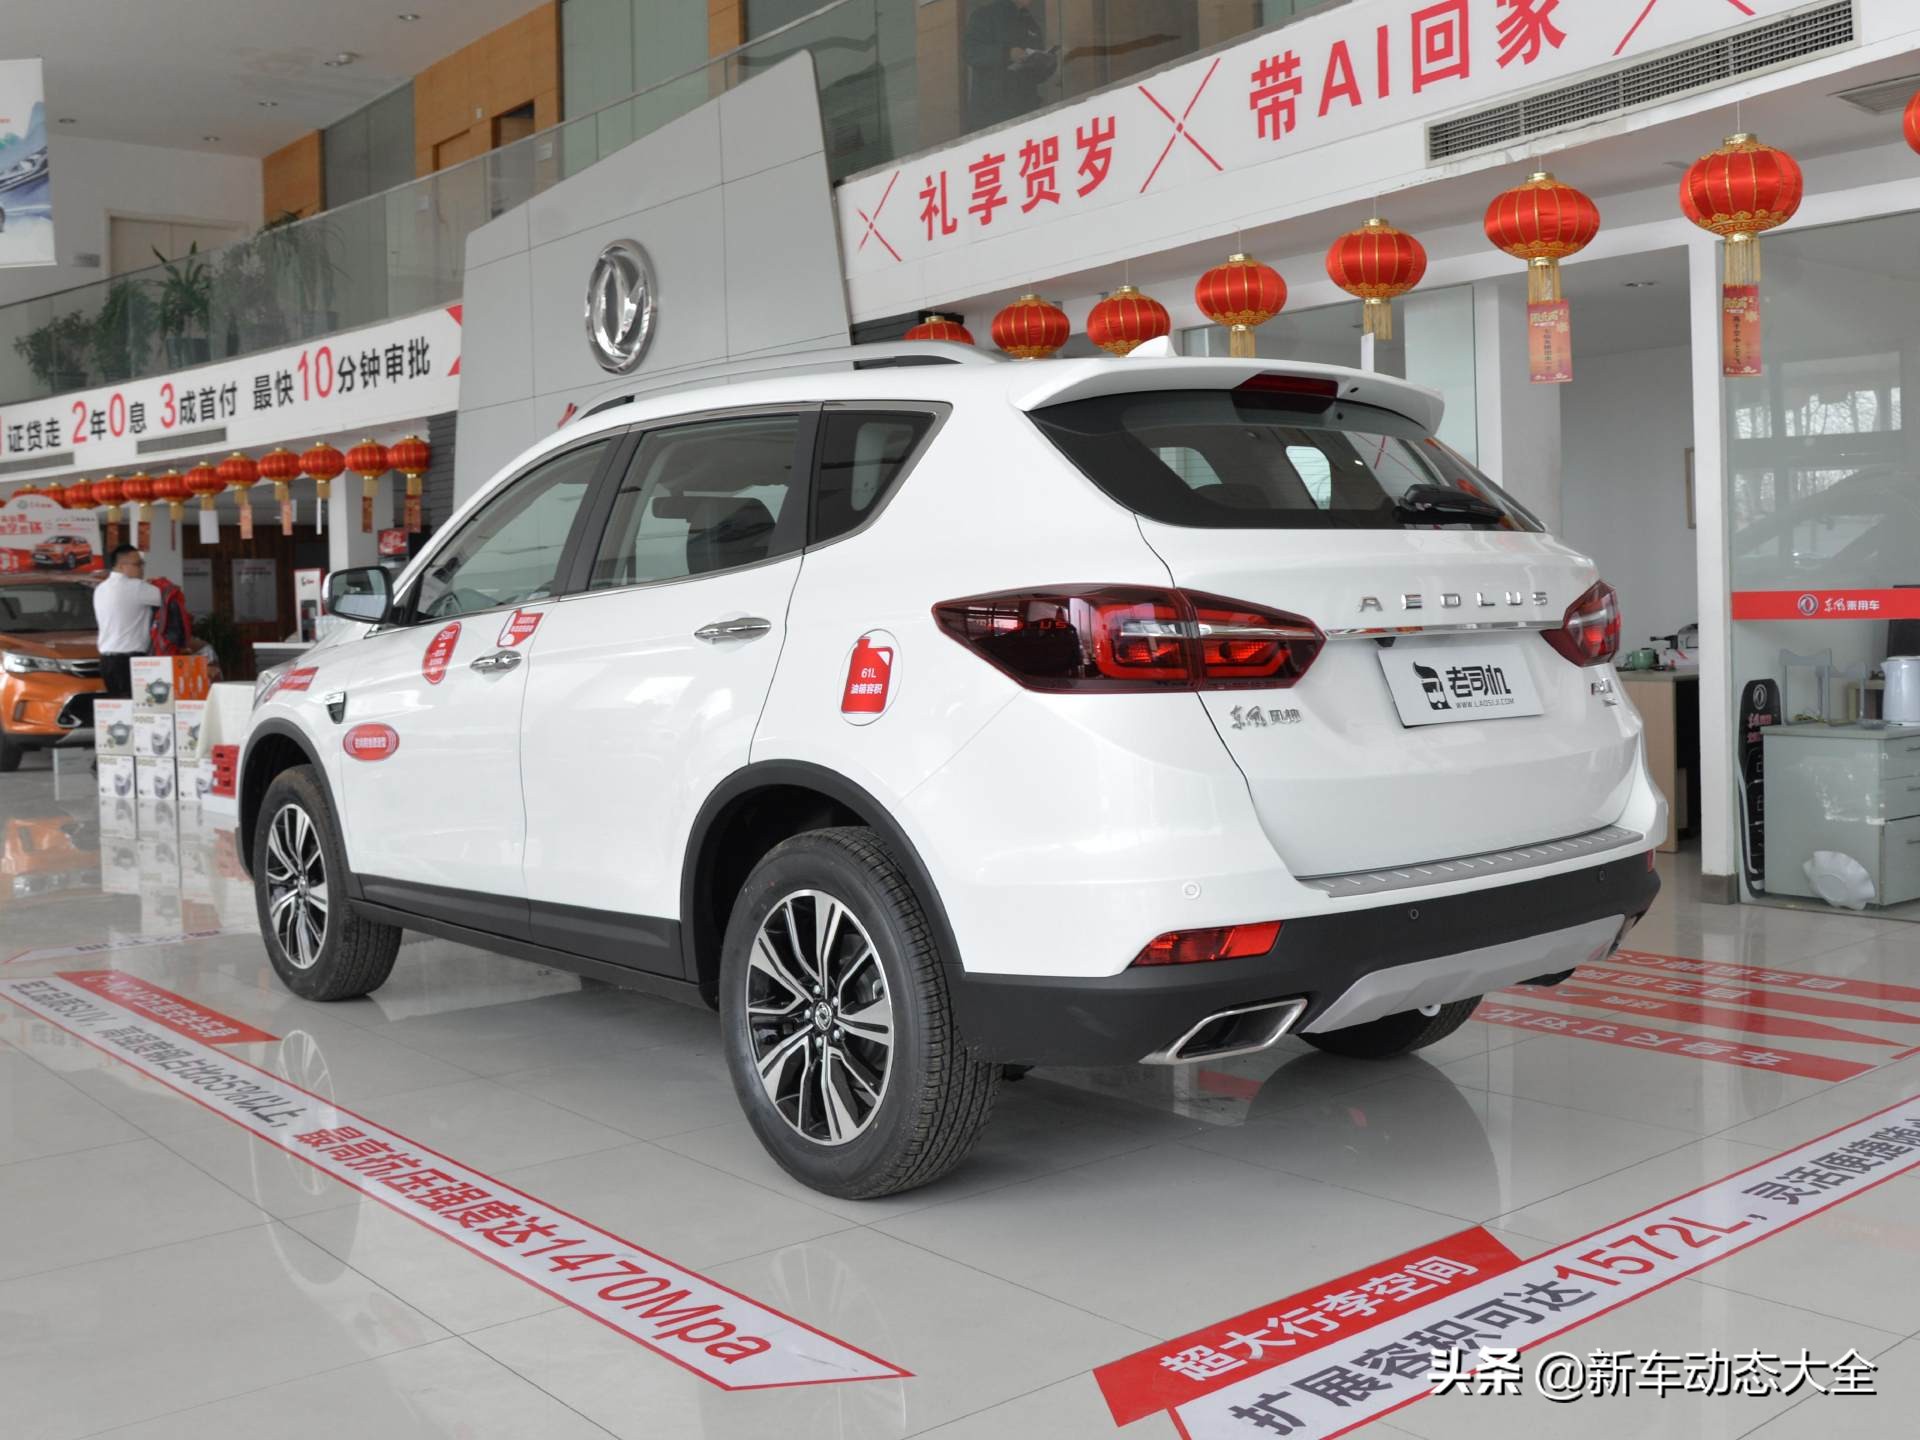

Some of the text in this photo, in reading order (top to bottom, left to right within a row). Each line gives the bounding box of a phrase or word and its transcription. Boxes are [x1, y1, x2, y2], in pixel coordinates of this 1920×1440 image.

[919, 0, 1568, 241] 礼享贺岁 带AI回家
[71, 392, 147, 445] 2年0息
[160, 381, 238, 430] 3成首付
[252, 336, 431, 411] 最快10分钟审批
[1359, 591, 1548, 613] AEOLUS
[860, 667, 877, 679] 61L
[1445, 664, 1512, 698] 老司机
[1479, 1008, 1792, 1067] 车身尺寸对比
[1160, 1255, 1479, 1381] 超大行李空间
